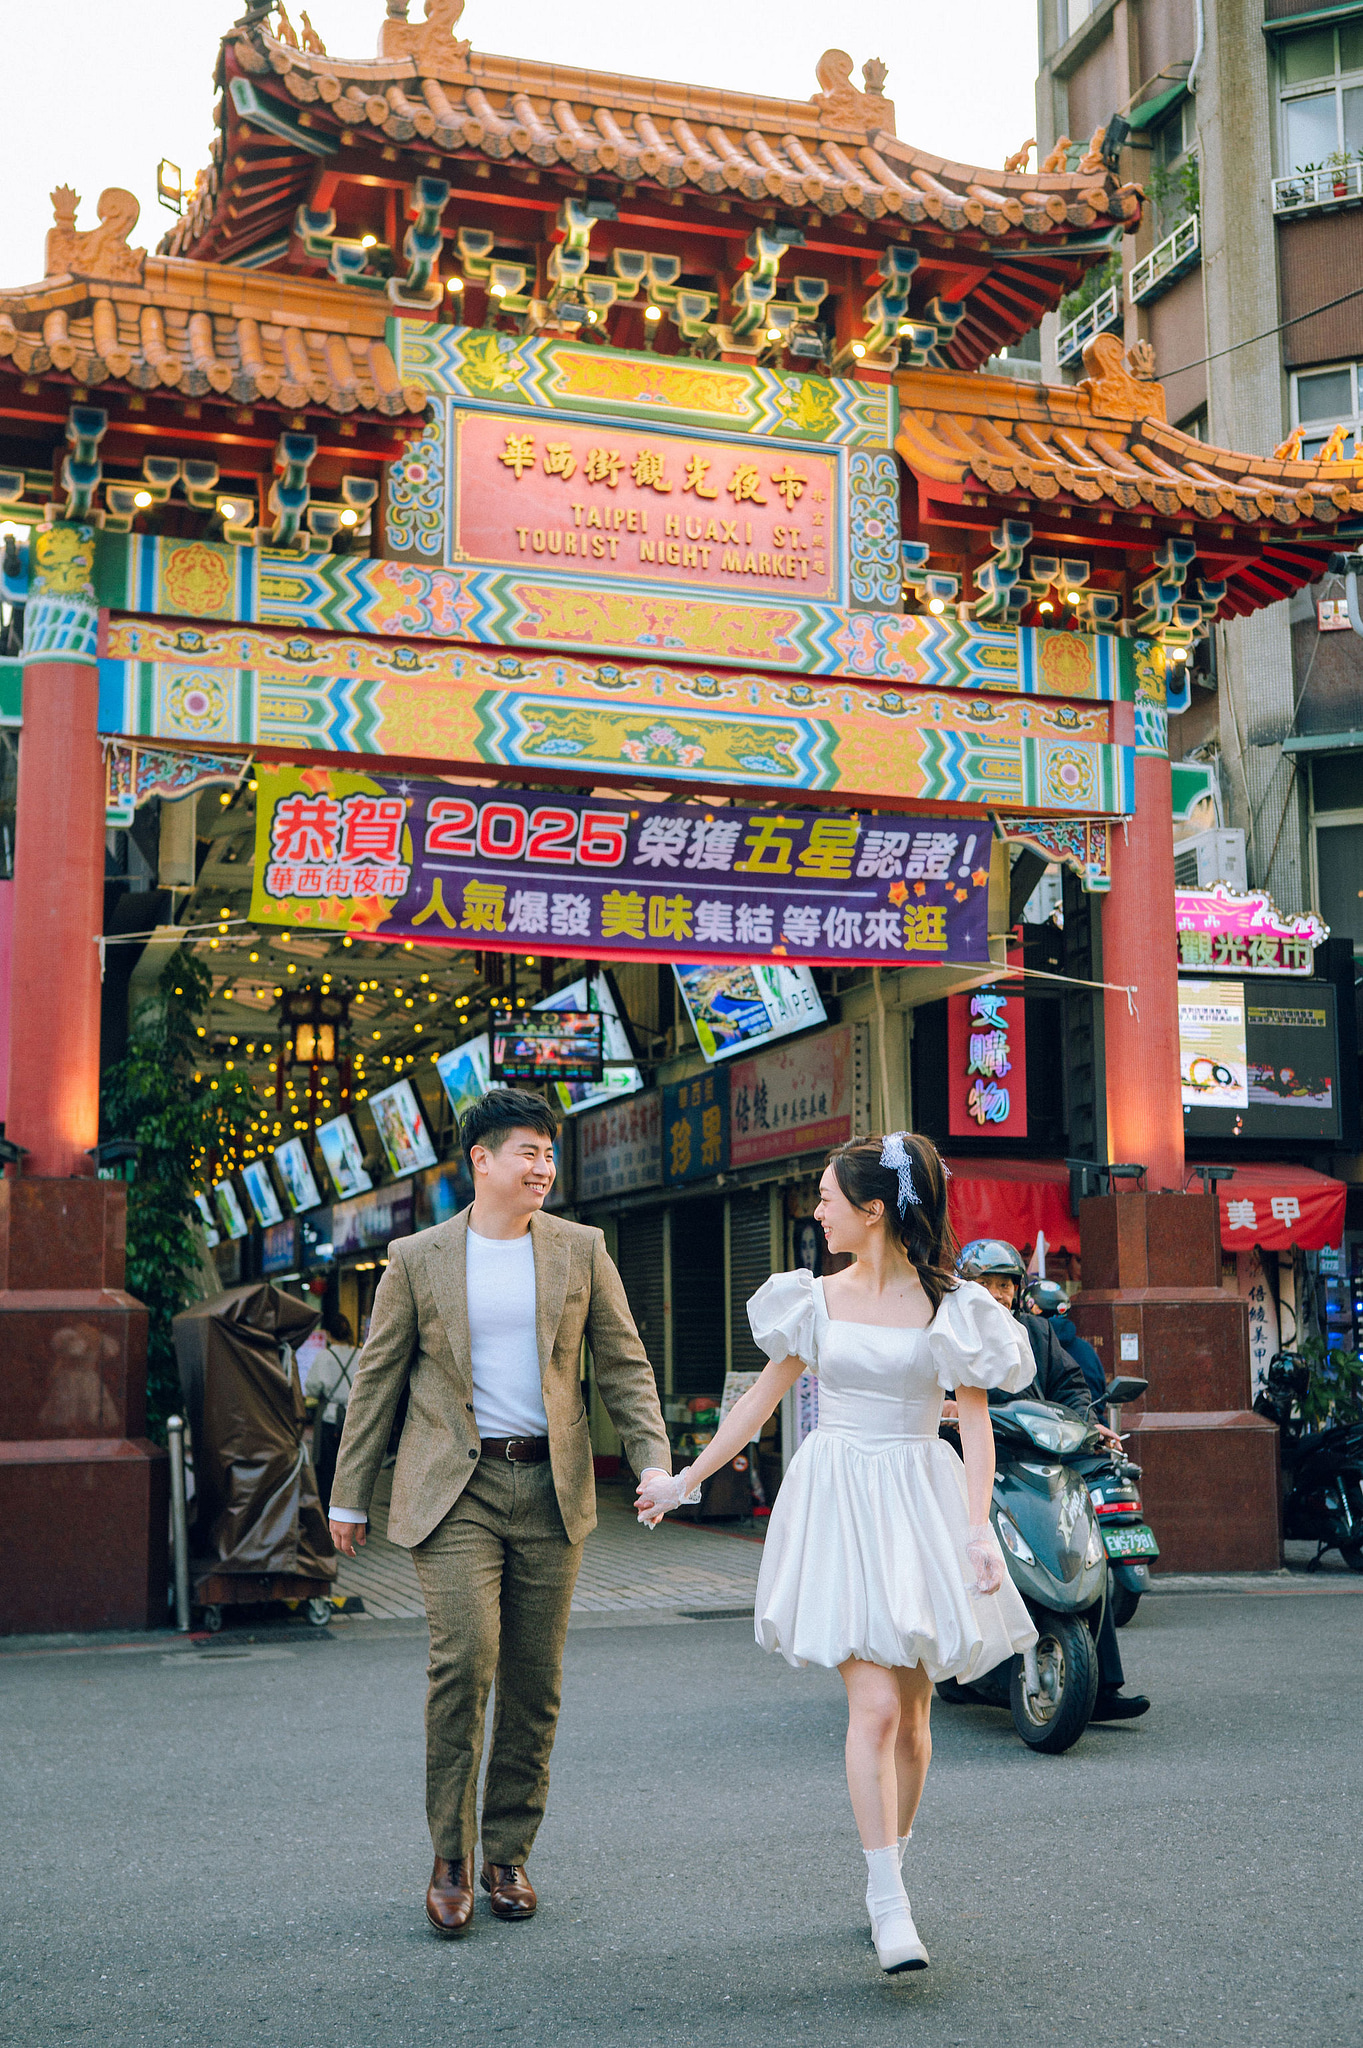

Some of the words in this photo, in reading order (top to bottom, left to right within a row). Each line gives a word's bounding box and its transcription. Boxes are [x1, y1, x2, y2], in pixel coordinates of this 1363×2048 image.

[499, 432, 808, 509] 華西街觀光夜市
[571, 503, 648, 534] TAIPEI
[664, 513, 752, 545] HUAXI
[773, 525, 807, 550] ST.
[515, 526, 619, 560] TOURIST
[640, 539, 711, 569] NIGHT
[721, 550, 810, 580] MARKET
[274, 798, 404, 864] 恭賀
[426, 798, 631, 866] 2025
[270, 866, 407, 894] 華西街夜市
[411, 877, 591, 937] 人氣爆發
[602, 889, 774, 944] 美味集結
[782, 903, 949, 951] 等你來逛
[1179, 930, 1313, 968] 觀光夜市
[767, 986, 821, 1024] TAIPEI
[1226, 1197, 1301, 1231] 美甲
